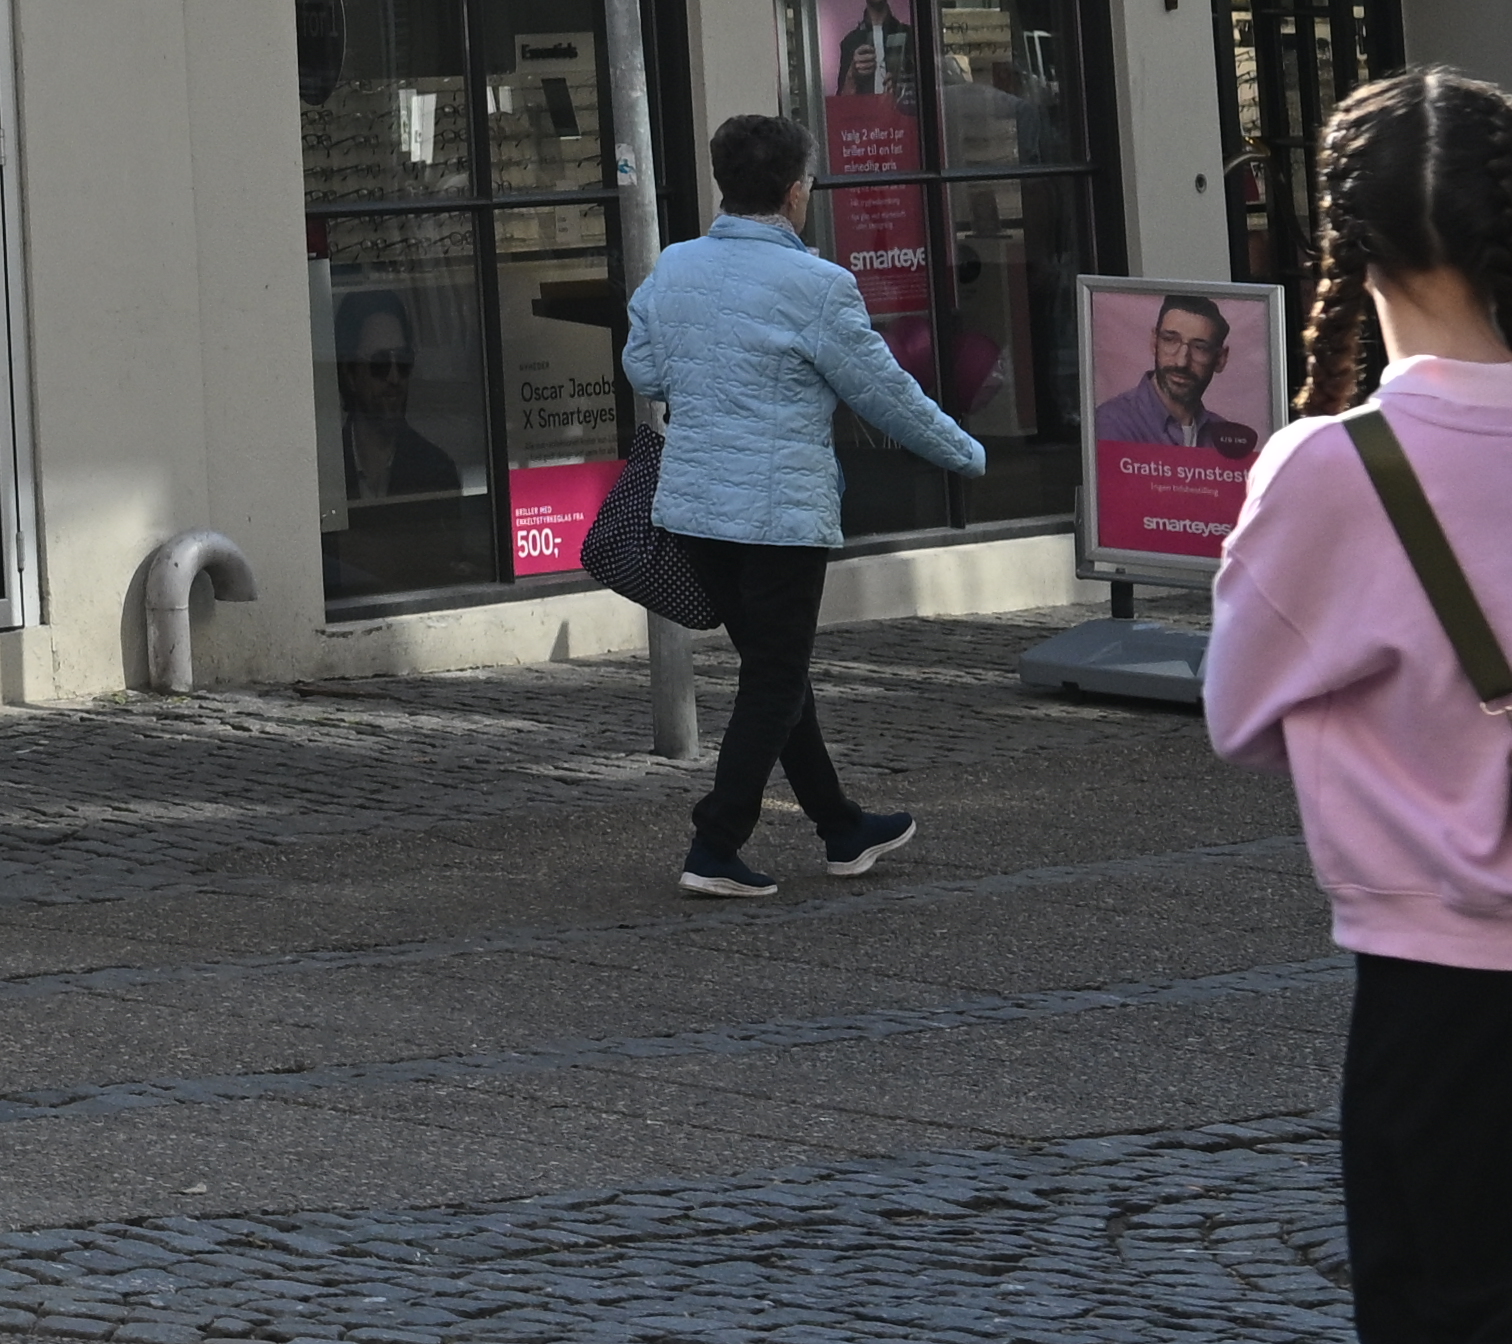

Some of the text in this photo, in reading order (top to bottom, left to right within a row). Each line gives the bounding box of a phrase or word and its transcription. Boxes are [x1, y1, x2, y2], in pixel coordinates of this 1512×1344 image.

[521, 381, 564, 402] Oscar
[523, 406, 615, 430] X Smarteyes
[1120, 457, 1172, 477] Gratis
[1143, 516, 1232, 537] smarteyes
[517, 528, 562, 559] 500,-
